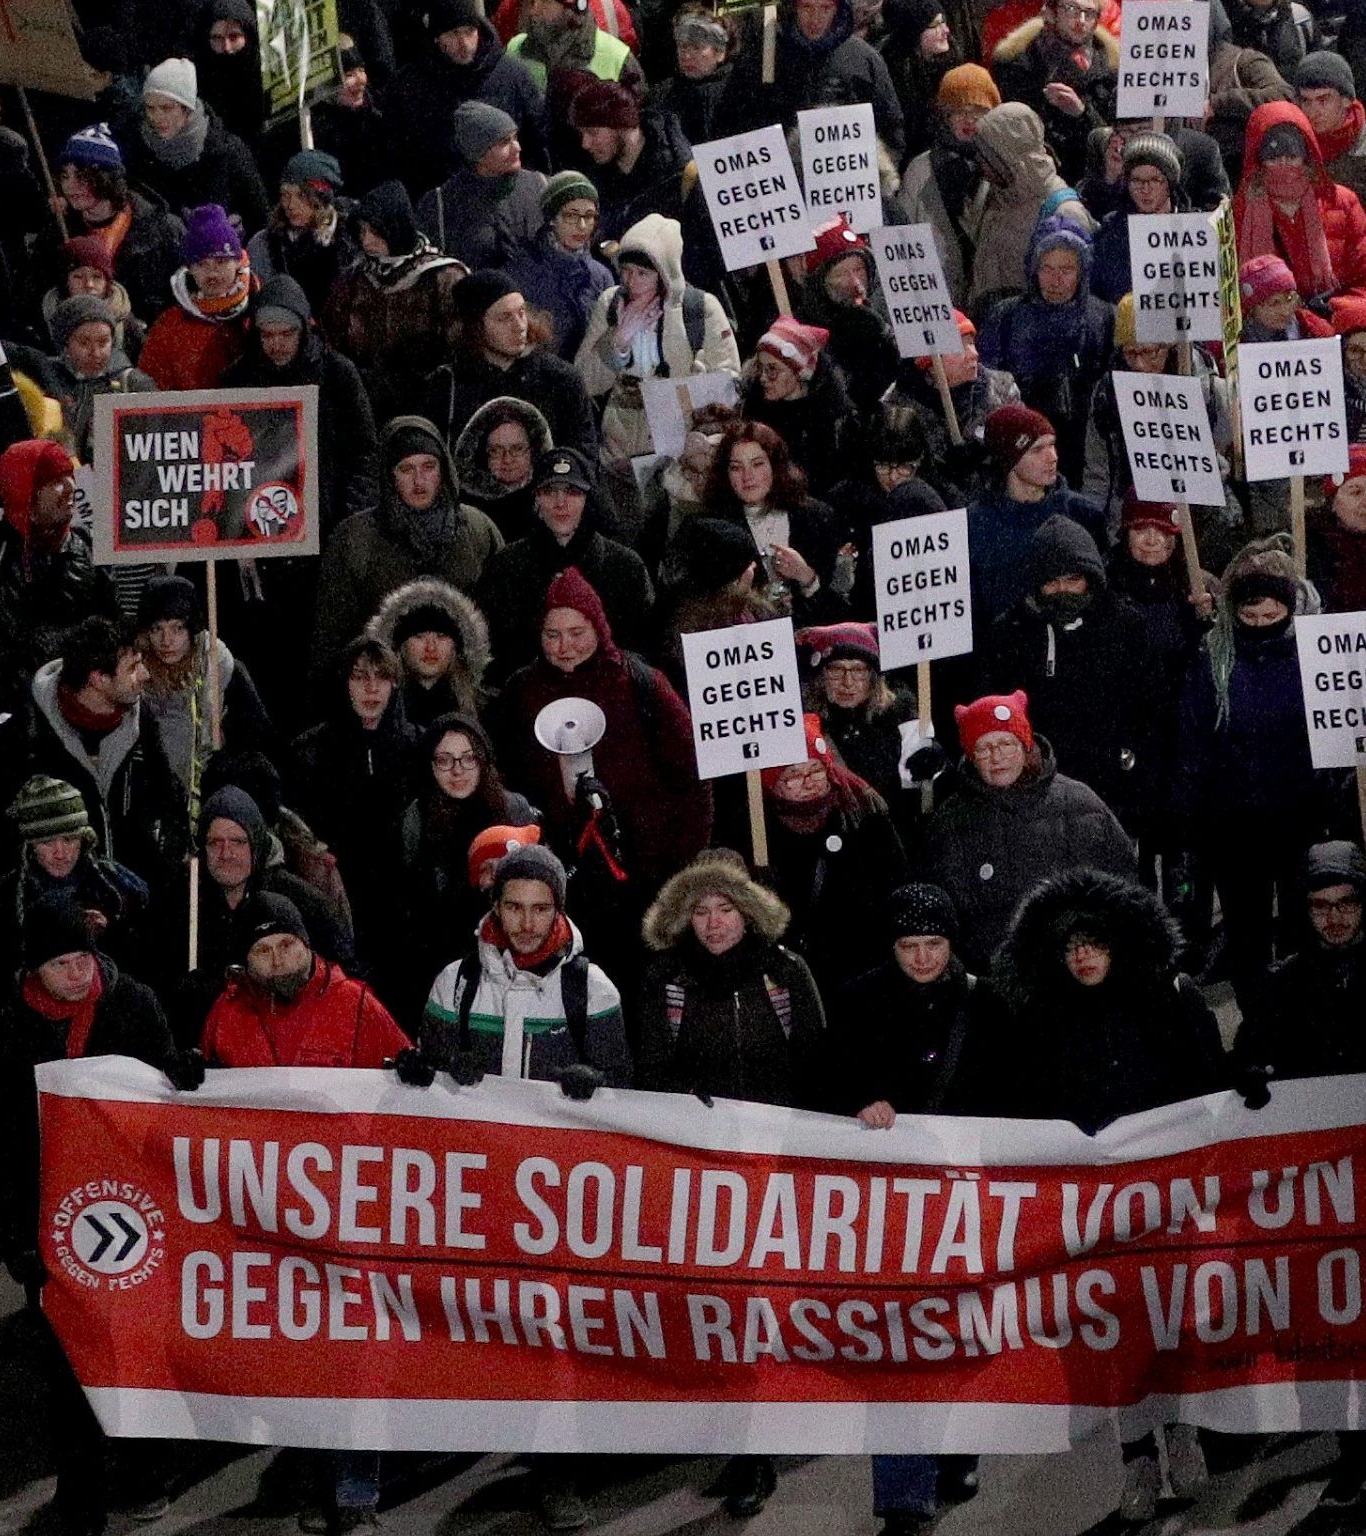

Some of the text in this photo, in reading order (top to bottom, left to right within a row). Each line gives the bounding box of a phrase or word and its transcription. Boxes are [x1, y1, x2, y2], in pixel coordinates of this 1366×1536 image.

[1136, 14, 1193, 33] OMAS
[1129, 42, 1196, 62] GEGEN
[1122, 69, 1201, 89] RECHTS
[813, 122, 862, 142] OMAS
[713, 145, 772, 176] OMAS
[812, 149, 871, 176] GEGEN
[716, 174, 789, 208] GEGEN
[809, 181, 878, 208] RECHTS
[719, 202, 803, 239] RECHTS
[883, 242, 926, 263] OMAS
[1147, 228, 1208, 251] OMAS
[888, 270, 938, 293] GEGEN
[1142, 258, 1217, 281] GEGEN
[1139, 287, 1220, 313] RECHTS
[892, 302, 952, 325] RECHTS
[1257, 357, 1323, 379] OMAS
[1132, 390, 1190, 411] OMAS
[1253, 387, 1333, 412] GEGEN
[1132, 420, 1202, 442] GEGEN
[1249, 420, 1341, 446] RECHTS
[125, 430, 200, 463] WIEN
[1133, 449, 1214, 474] RECHTS
[157, 460, 257, 495] WEHRT
[125, 497, 190, 530] SICH
[889, 530, 951, 559] OMAS
[885, 563, 958, 596] GEGEN
[882, 598, 967, 633] RECHTS
[705, 639, 775, 670] OMAS
[701, 673, 786, 706] GEGEN
[698, 707, 797, 743] RECHTS
[172, 1135, 489, 1252] UNSERE
[514, 1155, 1037, 1275] SOLIDARITÄT
[1060, 1174, 1222, 1258] VON
[180, 1249, 423, 1342] GEGEN
[439, 1274, 668, 1360] IHREN
[686, 1267, 1122, 1365] RASSISMUS
[1140, 1255, 1291, 1352] VON
